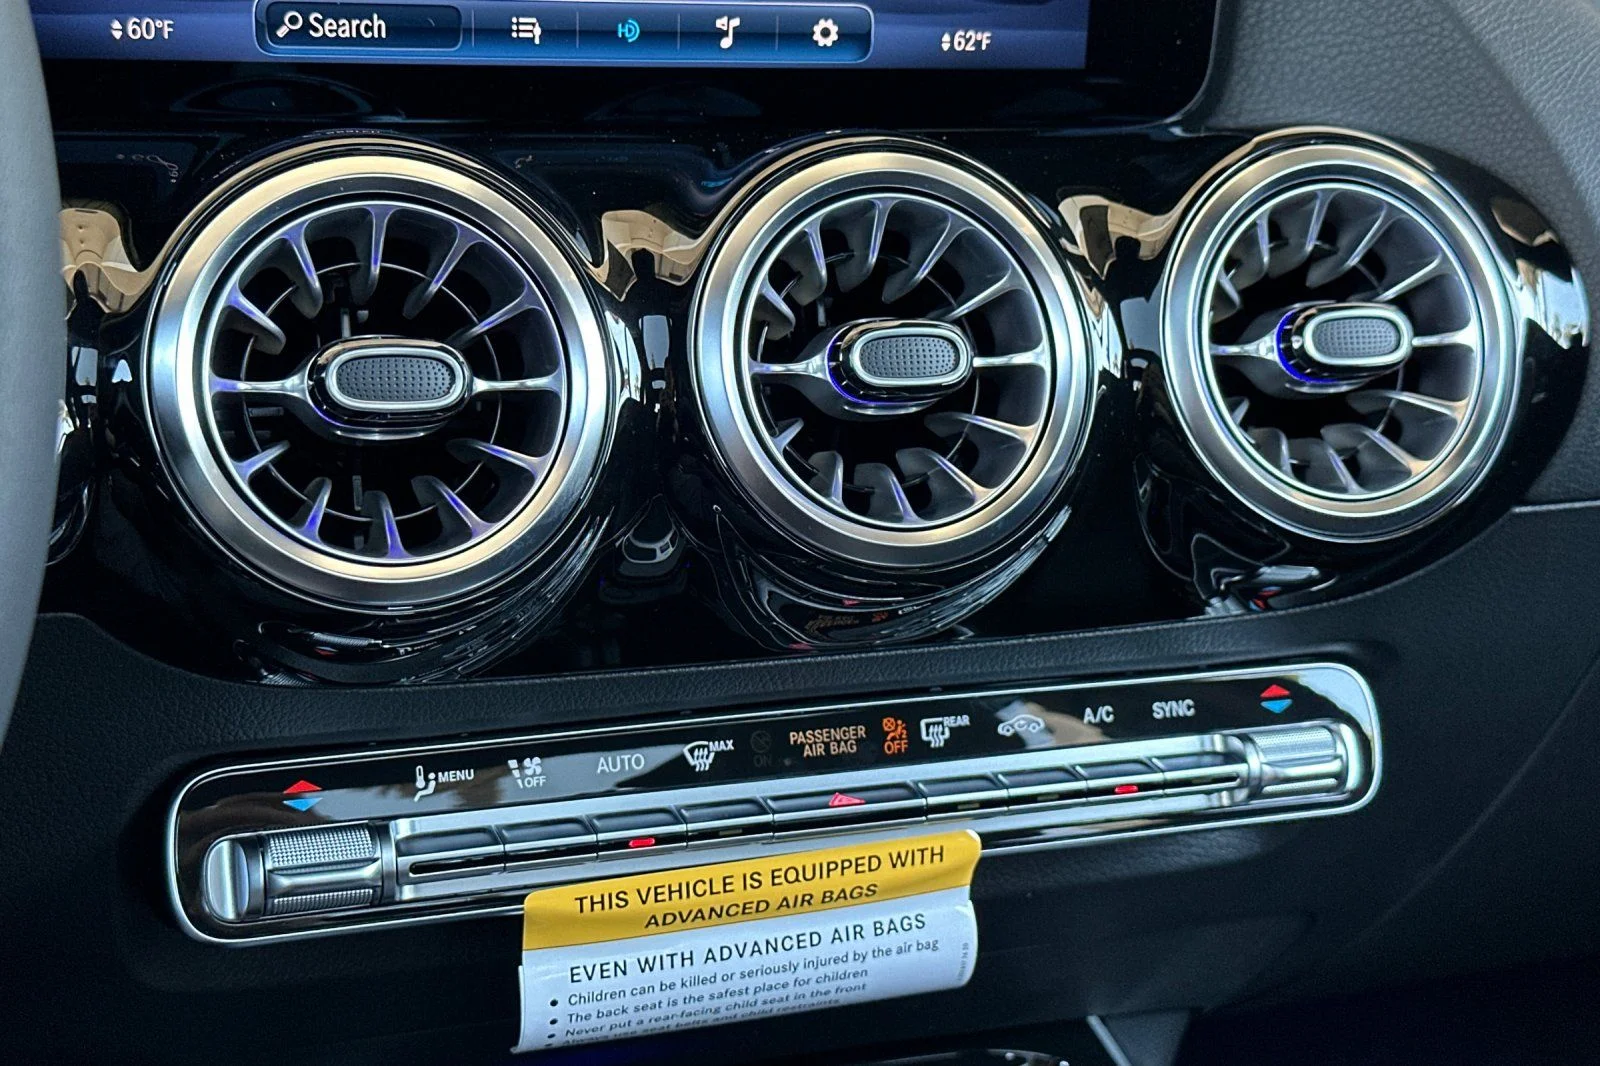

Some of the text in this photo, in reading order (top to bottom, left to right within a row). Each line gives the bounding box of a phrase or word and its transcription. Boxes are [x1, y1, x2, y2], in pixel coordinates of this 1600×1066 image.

[126, 18, 174, 40] 60°F
[309, 13, 386, 39] Search
[953, 30, 992, 51] 62°F
[1083, 705, 1114, 724] A/C
[1152, 699, 1195, 719] SYNC
[943, 714, 970, 728] REAR
[789, 725, 866, 745] PASSENGER
[708, 739, 734, 752] MAX
[803, 740, 857, 758] AIR BAG
[884, 739, 908, 755] OFF
[597, 753, 645, 773] AUTO
[437, 769, 475, 783] MENU
[524, 776, 547, 788] OFF
[575, 845, 944, 914] THIS VEHICLE IS EQUIPPED WITH
[644, 884, 878, 928] ADVANCED AIR BAGS
[570, 913, 926, 983] EVEN WITH ADVANCED AIR BAGS
[568, 938, 939, 1006] Children can be killed or seriously injured by the air bag
[568, 969, 868, 1024] The back seat is the safest place for children
[565, 983, 867, 1037] Never put a rear-facing child seat in the front
